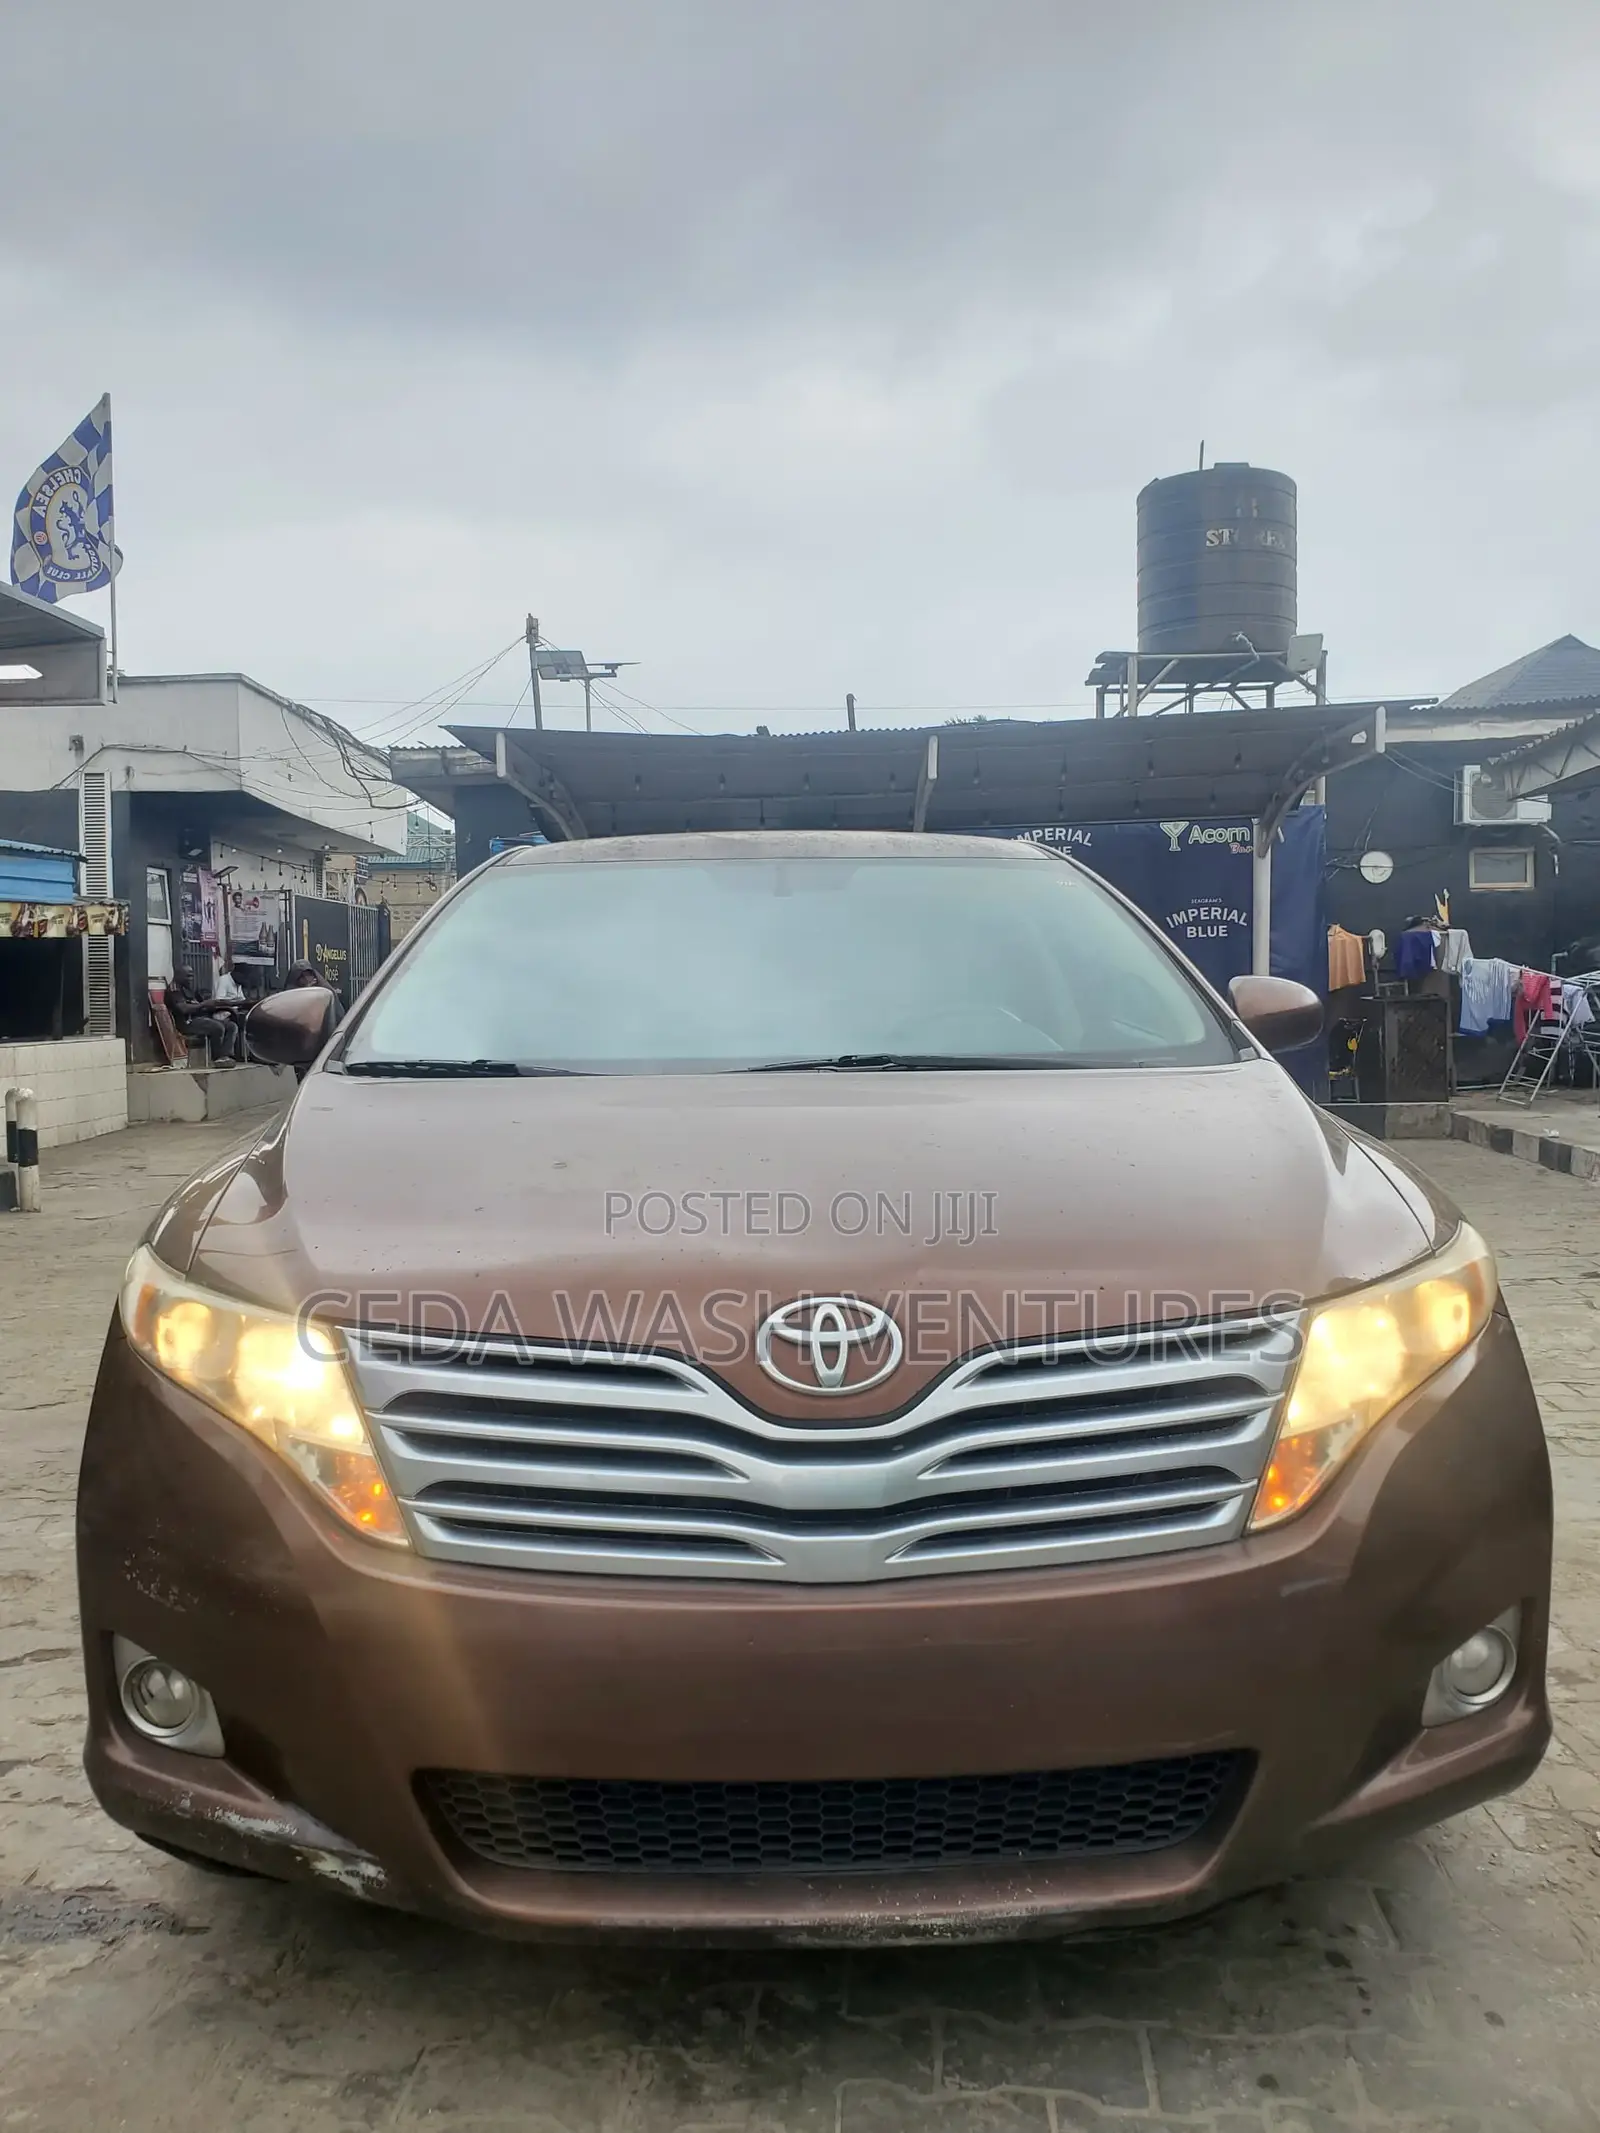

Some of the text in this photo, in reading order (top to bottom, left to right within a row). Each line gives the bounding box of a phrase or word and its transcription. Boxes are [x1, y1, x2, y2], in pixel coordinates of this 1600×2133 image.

[1011, 827, 1092, 847] MPERIAL
[1188, 824, 1250, 844] Acorn
[1166, 906, 1248, 928] IMPERIAL
[1187, 925, 1228, 938] BLUE
